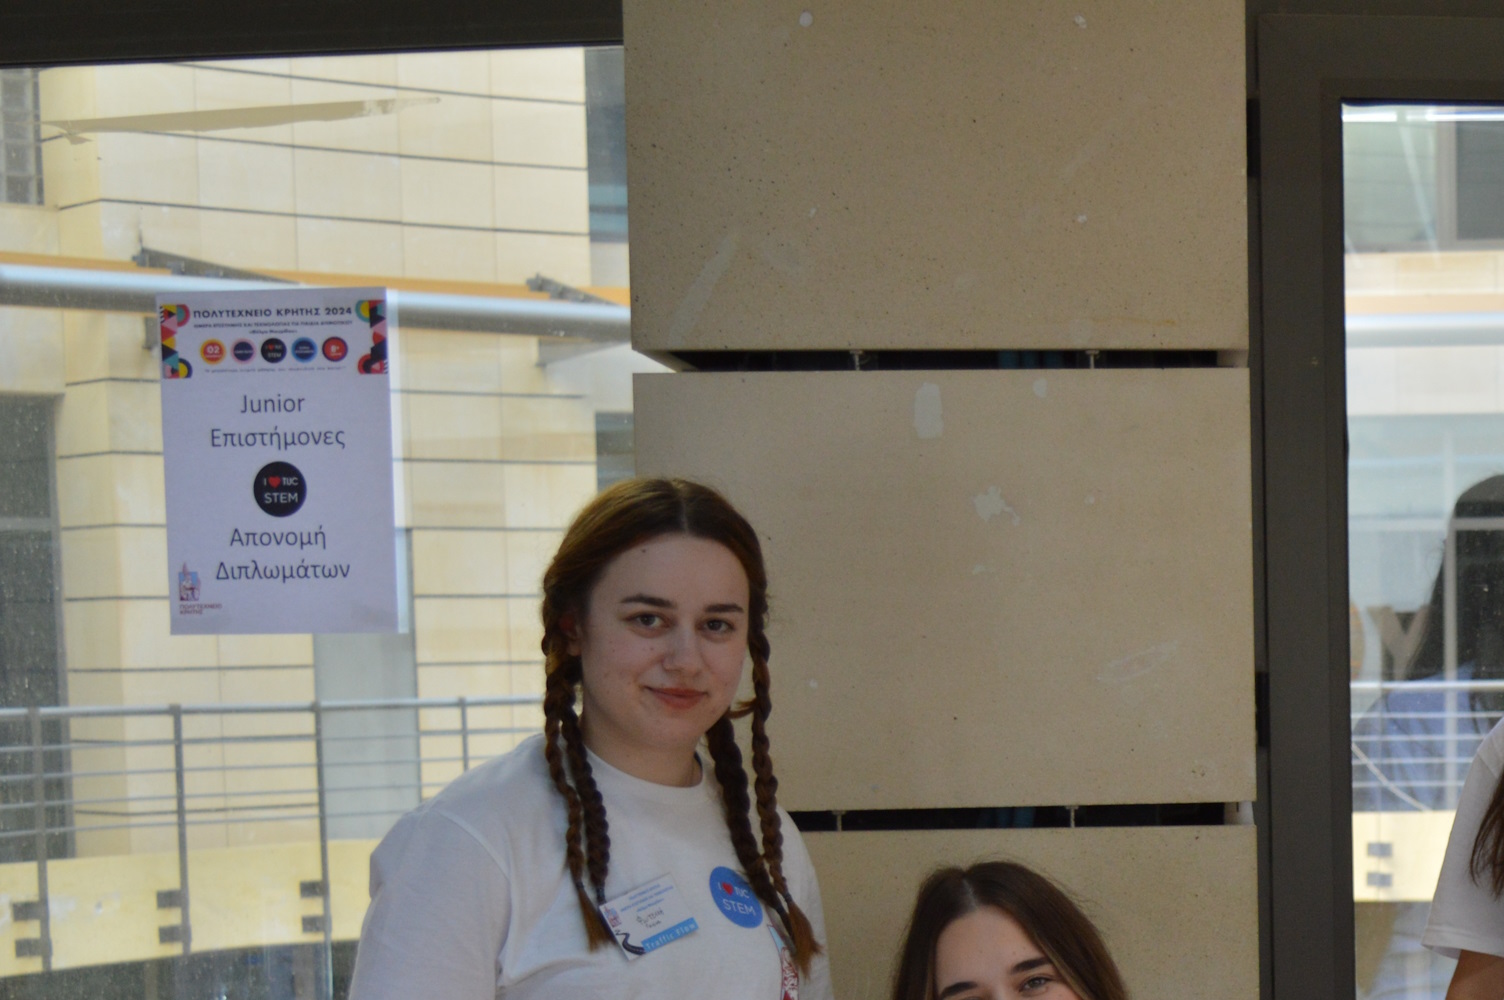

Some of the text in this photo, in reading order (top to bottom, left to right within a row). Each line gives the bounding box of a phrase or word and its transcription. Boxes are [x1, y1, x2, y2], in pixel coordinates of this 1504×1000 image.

[193, 307, 352, 318] ΠΟΛΥΤΕΧΝΕΙΟ ΚΡΗΤΗΣ 2024
[207, 345, 220, 354] 02
[240, 394, 305, 413] Junior
[211, 426, 345, 450] Επιστήμονες
[282, 477, 298, 486] TUC
[264, 493, 298, 504] STEM
[230, 525, 327, 549] Απονομή
[216, 559, 350, 583] Διπλωμάτων
[723, 899, 757, 916] STEM
[646, 932, 674, 950] Traffic
